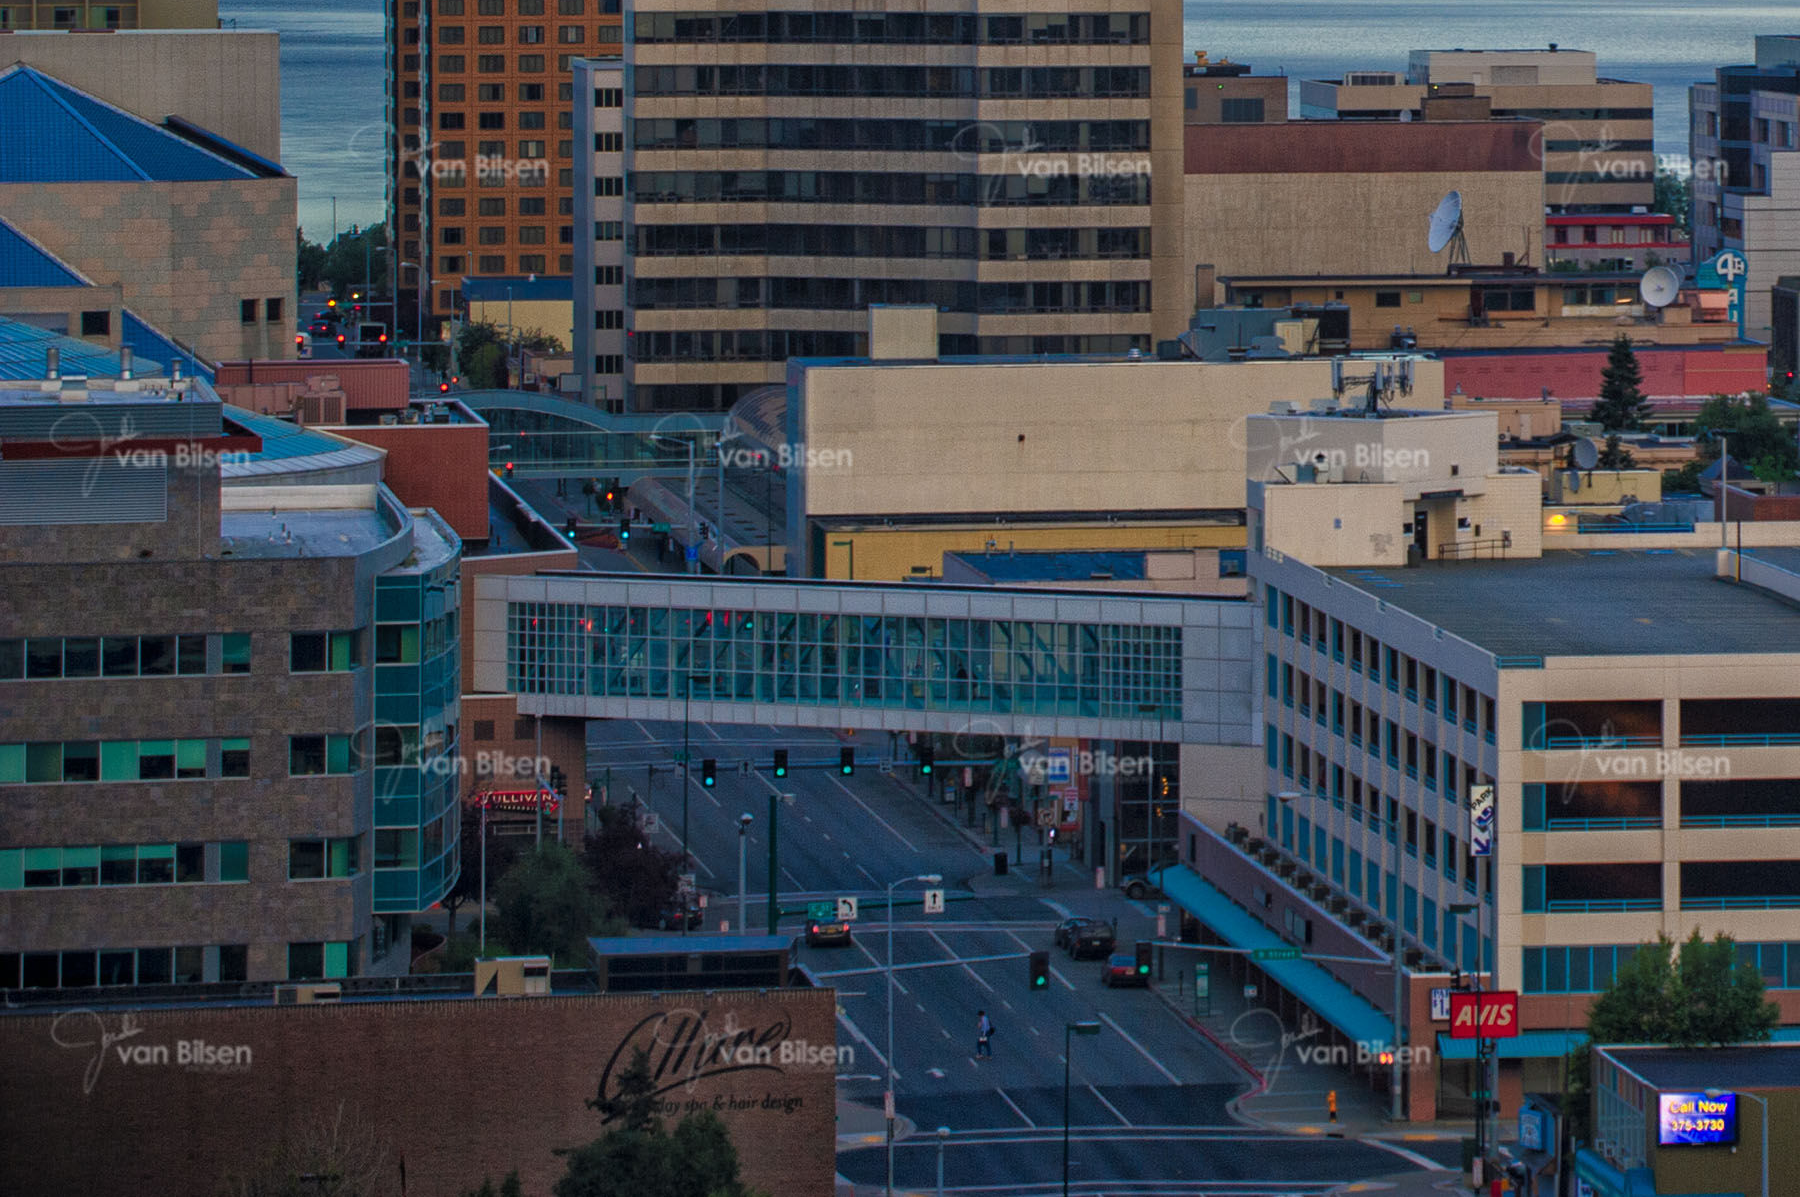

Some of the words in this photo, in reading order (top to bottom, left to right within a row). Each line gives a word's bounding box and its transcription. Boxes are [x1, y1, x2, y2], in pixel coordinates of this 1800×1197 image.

[1471, 787, 1494, 811] PARK
[1455, 1004, 1514, 1027] AVIS
[712, 1096, 727, 1110] &
[728, 1095, 758, 1110] hair
[761, 1094, 804, 1115] design
[1669, 1100, 1695, 1114] Call
[1698, 1100, 1727, 1114] Now
[1670, 1119, 1725, 1132] 375-3730
